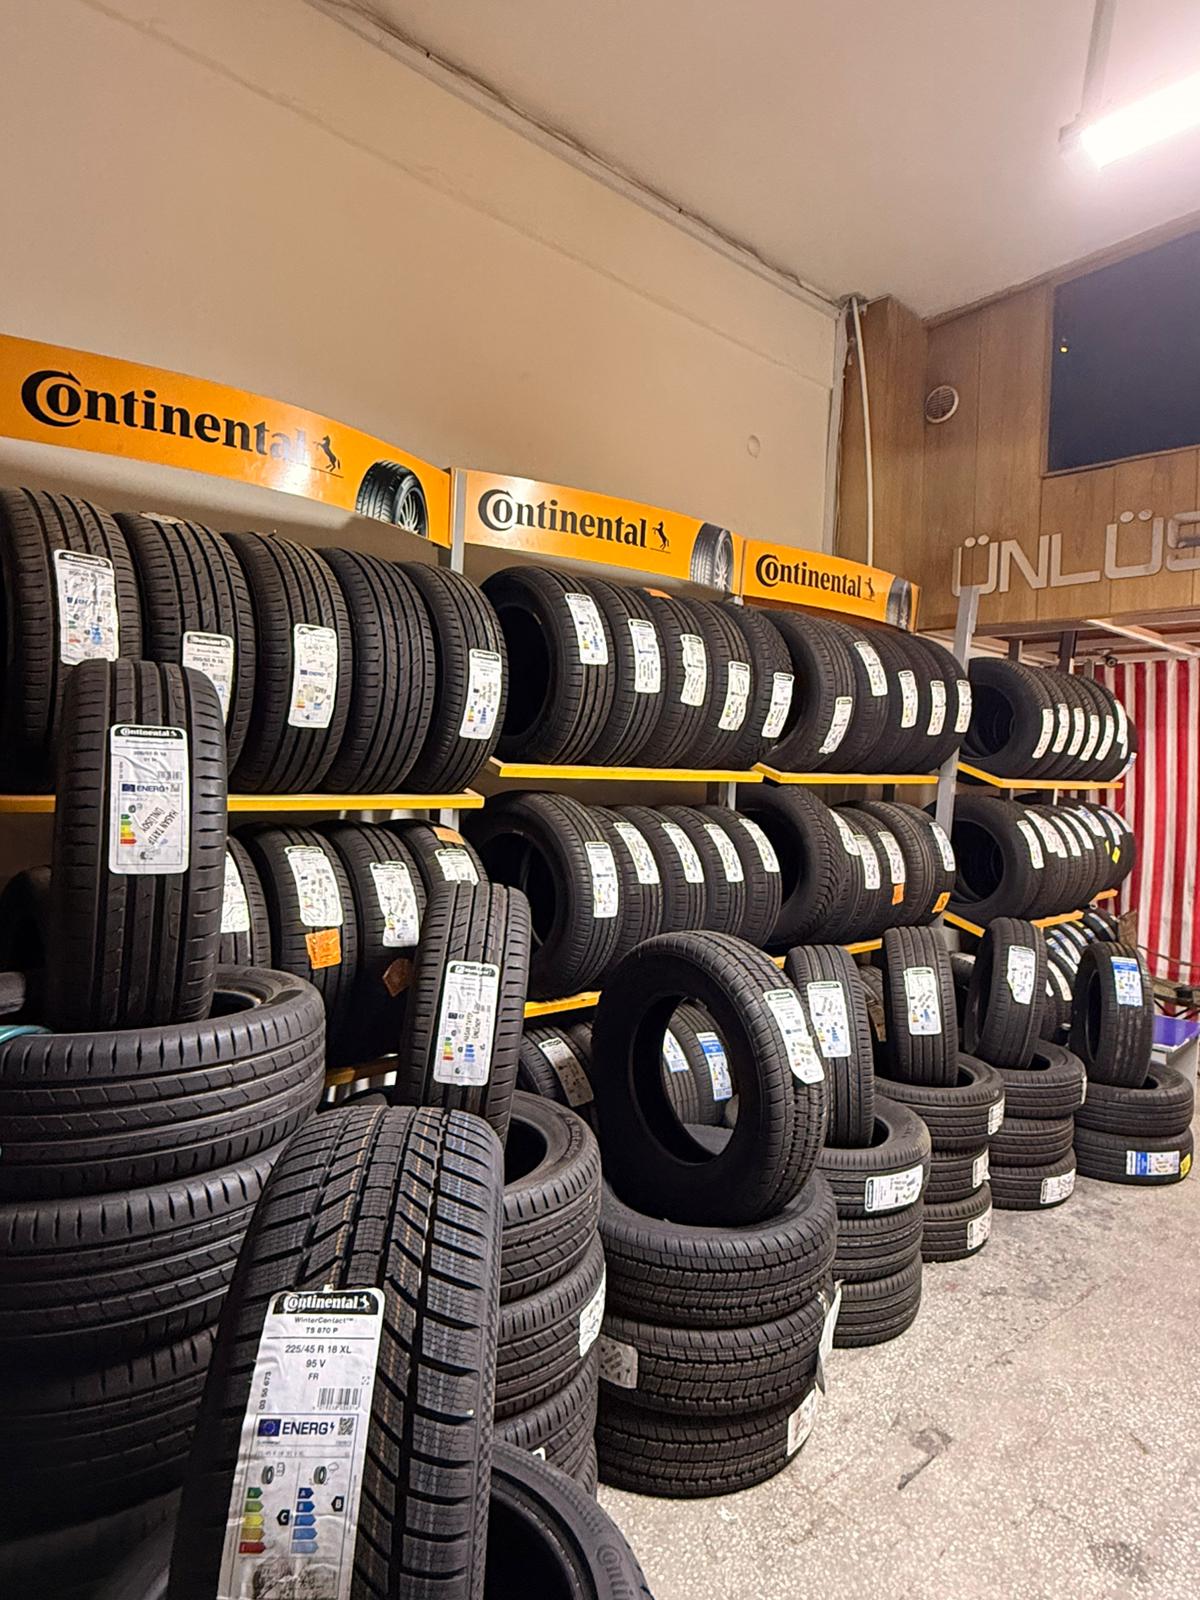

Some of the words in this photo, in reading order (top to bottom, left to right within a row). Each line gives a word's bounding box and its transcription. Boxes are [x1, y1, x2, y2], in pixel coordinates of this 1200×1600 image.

[21, 369, 309, 461] Continental
[477, 488, 647, 548] Continental
[755, 553, 862, 599] Continental
[120, 727, 170, 737] Continental
[283, 1294, 358, 1312] Continental
[285, 1344, 315, 1354] 225/45
[317, 1345, 324, 1353] R
[327, 1345, 338, 1354] 18
[339, 1345, 352, 1354] XL
[306, 1359, 317, 1368] 95
[319, 1359, 326, 1368] V
